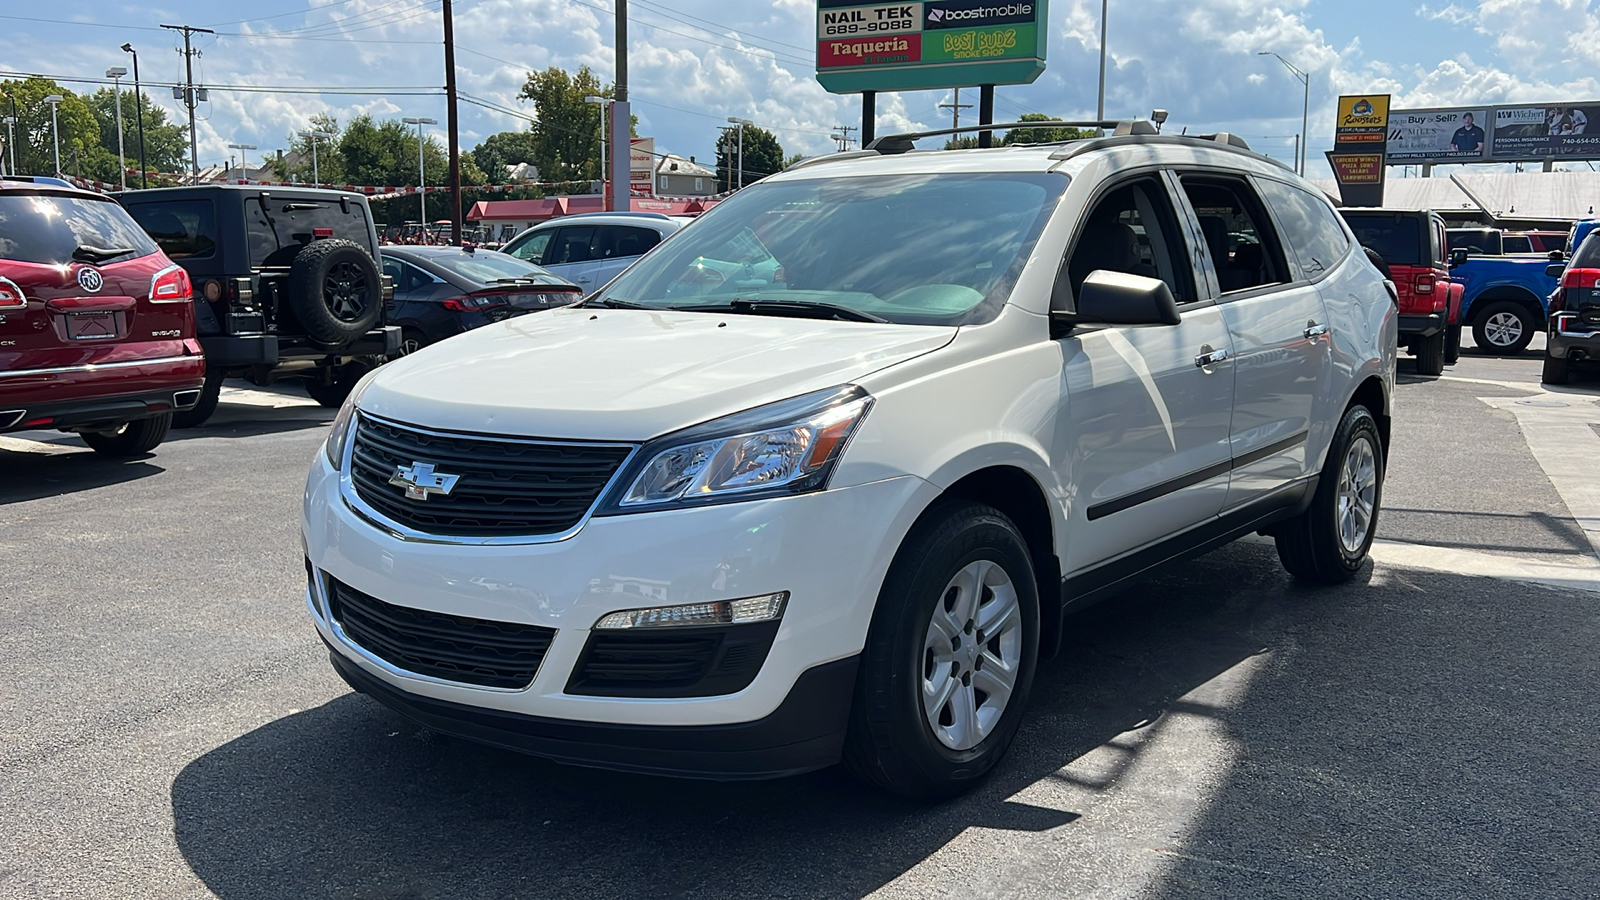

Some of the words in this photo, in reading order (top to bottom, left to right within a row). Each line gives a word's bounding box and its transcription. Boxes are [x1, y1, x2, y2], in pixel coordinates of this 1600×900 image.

[824, 10, 867, 24] NAIL
[873, 6, 914, 20] TEK
[945, 3, 1032, 20] boostmobile
[826, 20, 913, 35] 689-9088
[977, 29, 1016, 49] BUDZ
[953, 50, 980, 59] SMOKE
[981, 48, 1005, 57] SHOP
[1343, 114, 1382, 126] Roosters
[1408, 116, 1426, 124] Buy
[1436, 114, 1458, 122] Sell?
[1512, 110, 1544, 118] Wichert
